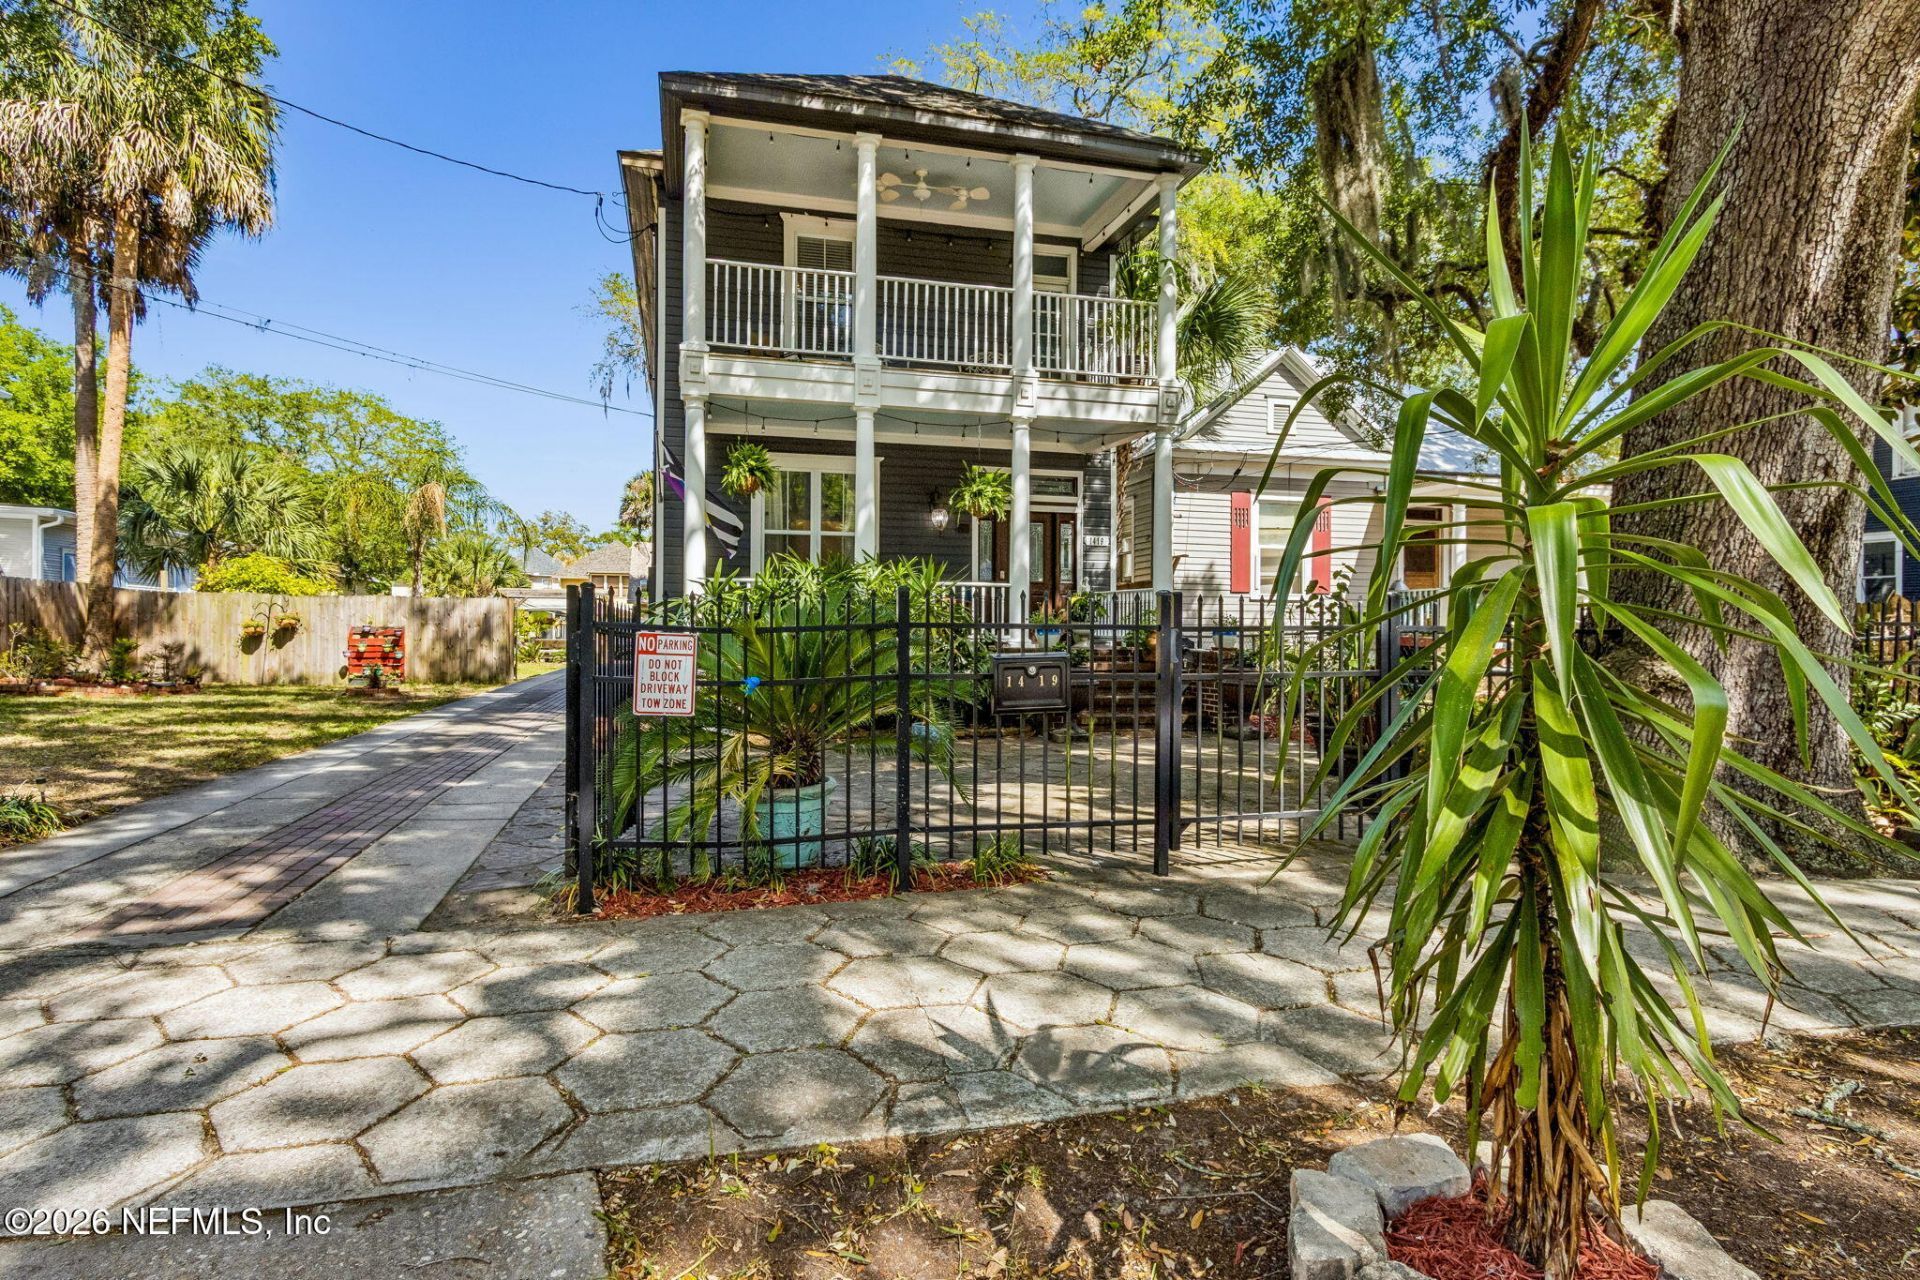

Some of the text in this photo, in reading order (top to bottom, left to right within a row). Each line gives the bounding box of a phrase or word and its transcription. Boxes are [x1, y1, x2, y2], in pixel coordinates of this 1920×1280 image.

[638, 636, 693, 651] NO PARKING
[648, 659, 682, 670] DO NOT
[649, 672, 680, 682] BLOCK
[640, 683, 688, 694] DRIVEWAY
[642, 698, 687, 709] TOW ZONE
